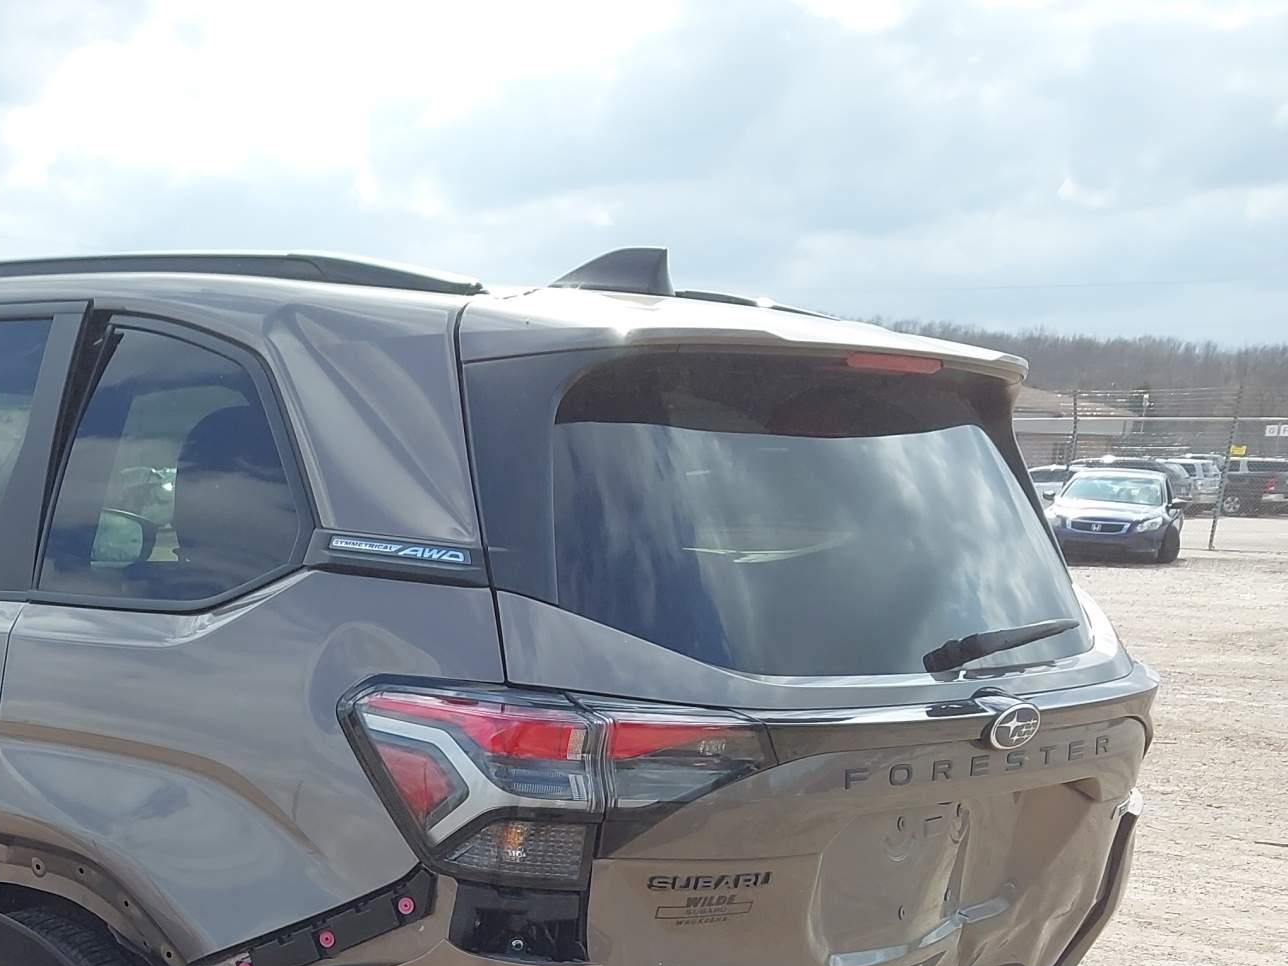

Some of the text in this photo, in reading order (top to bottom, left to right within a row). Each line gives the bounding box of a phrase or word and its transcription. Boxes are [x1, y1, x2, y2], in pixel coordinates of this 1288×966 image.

[333, 539, 466, 562] SYMMETRICAL AWD
[844, 734, 1110, 790] FORESTER
[647, 871, 772, 891] SUBARU
[686, 894, 737, 908] WILDE
